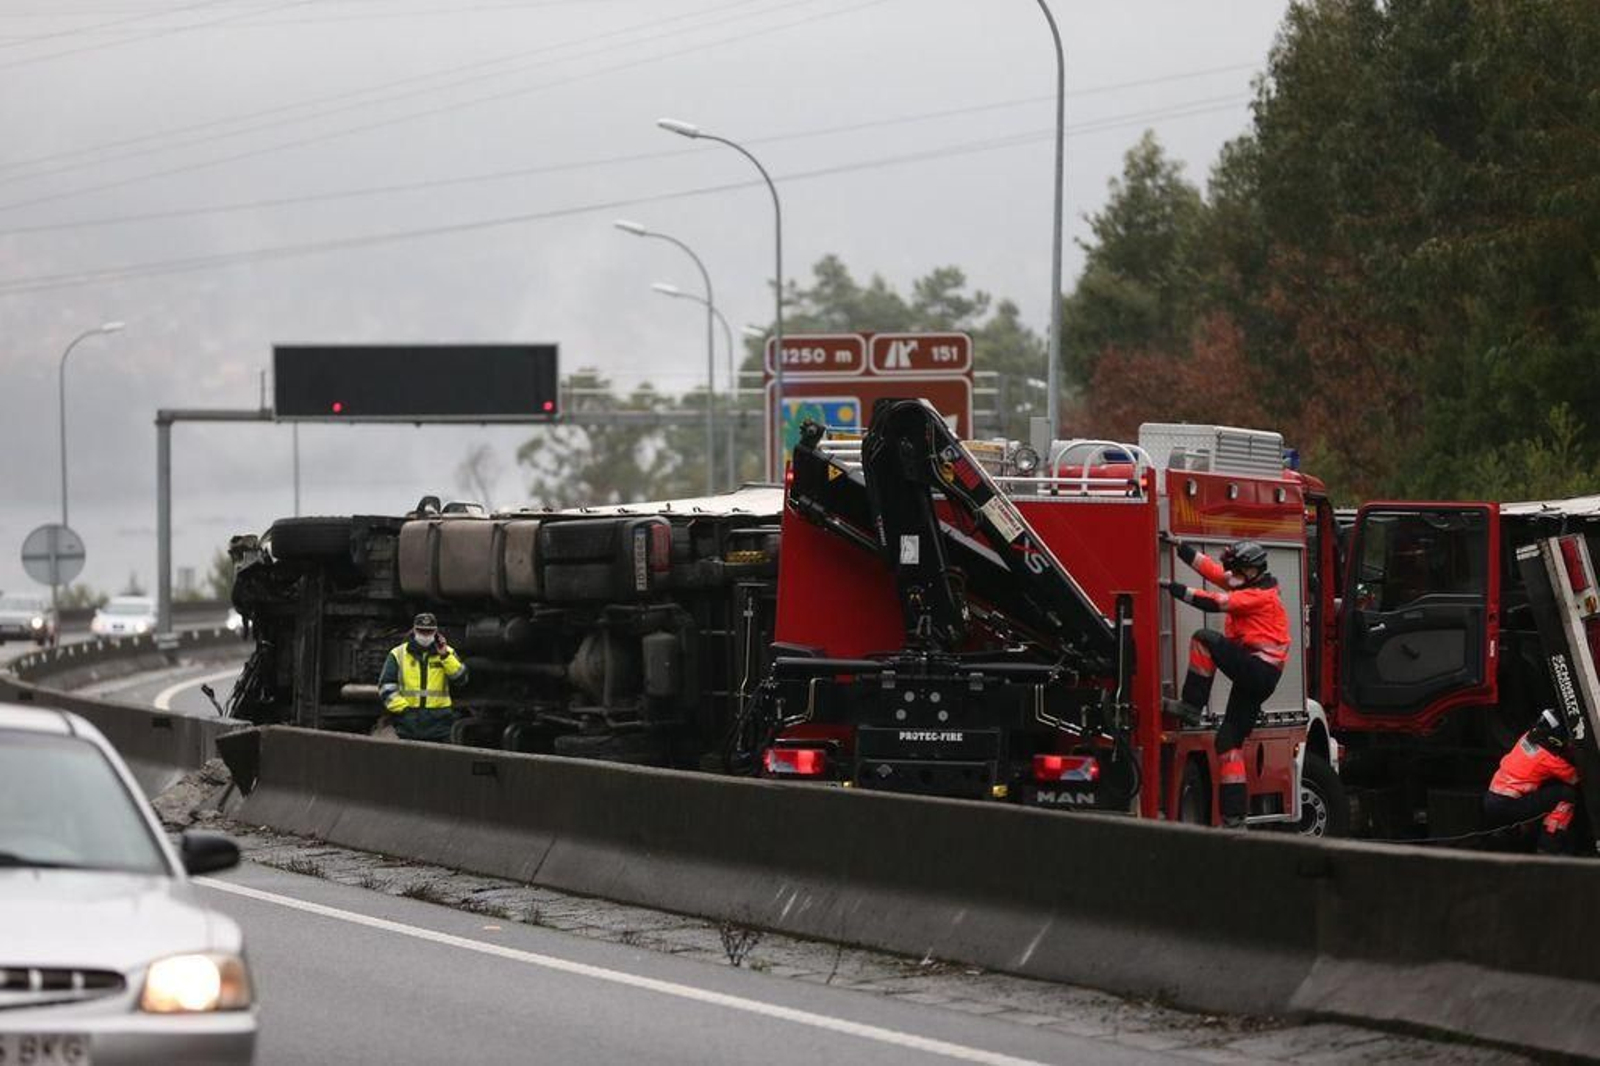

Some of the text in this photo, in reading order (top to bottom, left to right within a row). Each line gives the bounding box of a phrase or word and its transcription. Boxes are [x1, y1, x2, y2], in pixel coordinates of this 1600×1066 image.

[835, 350, 852, 362] m
[932, 346, 958, 361] 151
[1557, 654, 1580, 715] SCHMITZ
[899, 731, 963, 741] PROTEC-FIRE
[1036, 790, 1095, 804] MAN
